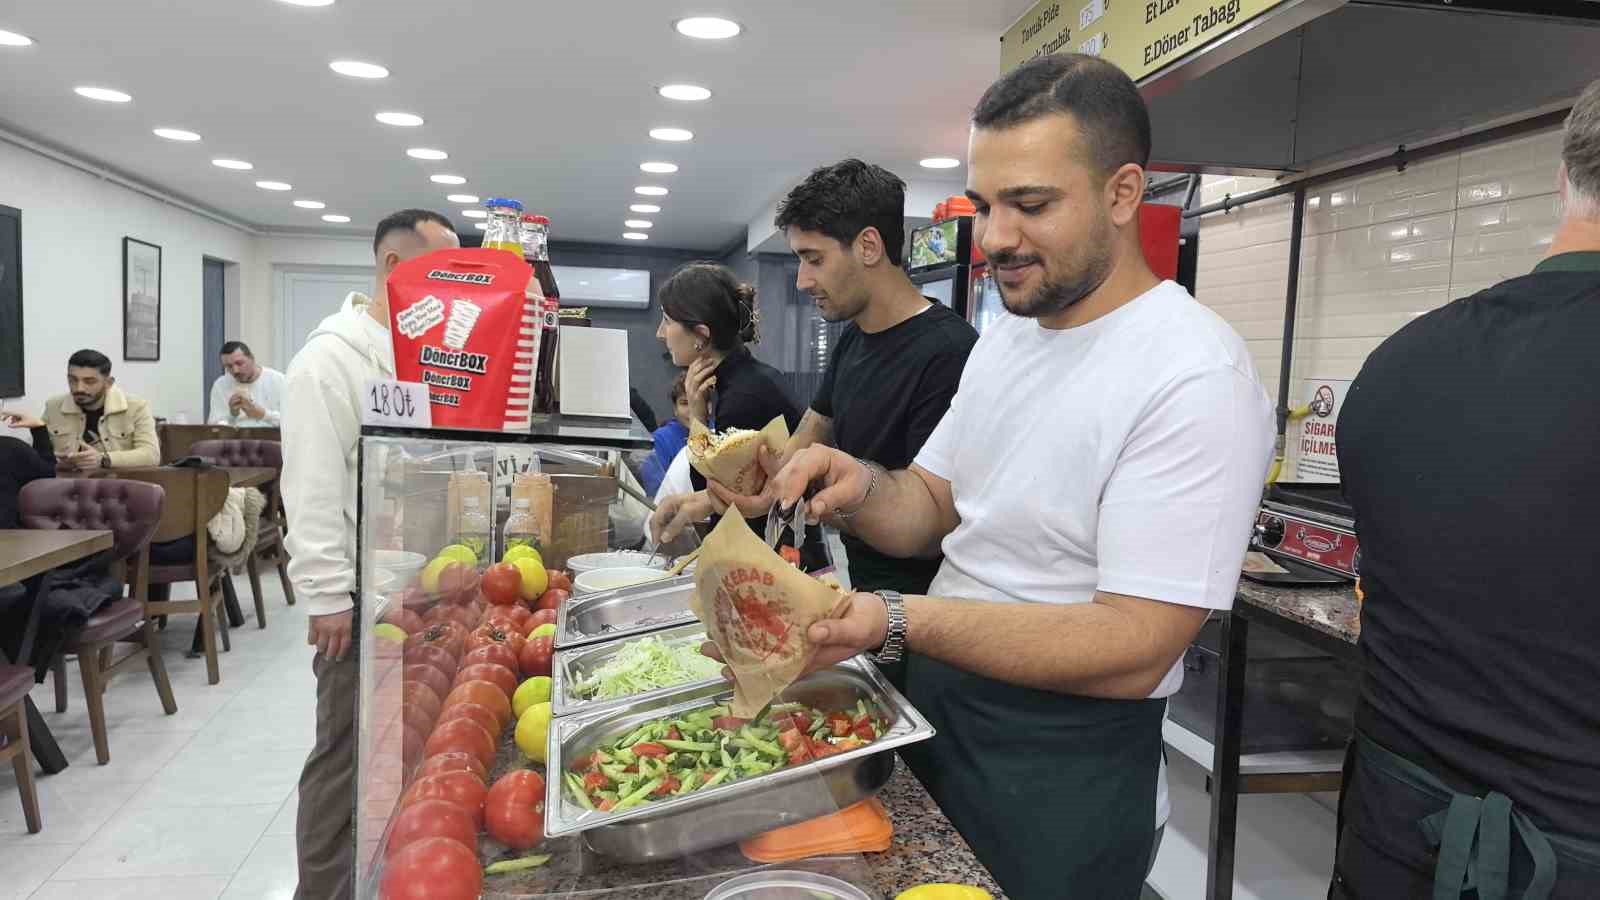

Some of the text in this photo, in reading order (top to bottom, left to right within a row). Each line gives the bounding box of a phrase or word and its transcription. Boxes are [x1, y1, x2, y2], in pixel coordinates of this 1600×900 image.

[1145, 2, 1157, 24] Et
[1143, 26, 1190, 66] E.Döner
[1304, 418, 1335, 437] SİGAR
[1301, 436, 1336, 456] İÇİLME
[720, 567, 775, 593] KEBAB
